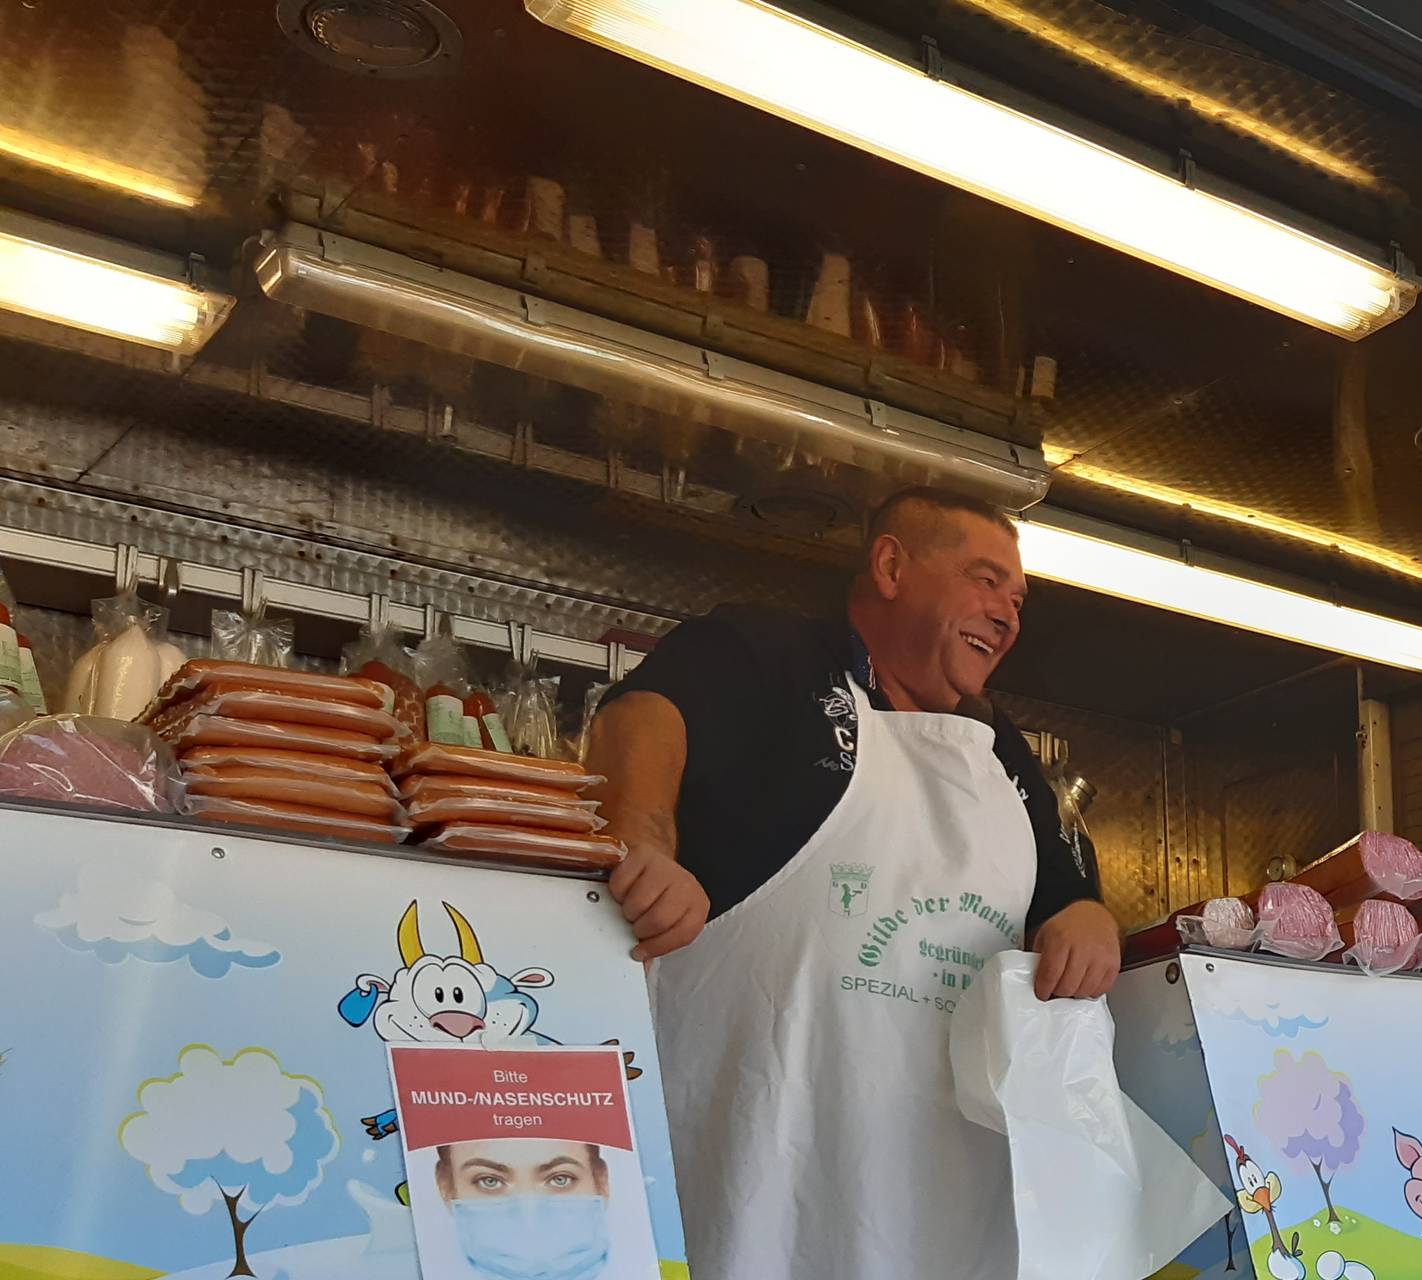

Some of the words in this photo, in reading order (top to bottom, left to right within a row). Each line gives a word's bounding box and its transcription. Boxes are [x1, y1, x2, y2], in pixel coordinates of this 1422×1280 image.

[911, 896, 950, 916] der
[840, 975, 919, 1004] SPEZIAL
[493, 1070, 528, 1084] Bitte
[411, 1090, 614, 1106] MUND-/NASENSCHUTZ
[493, 1113, 542, 1129] tragen
